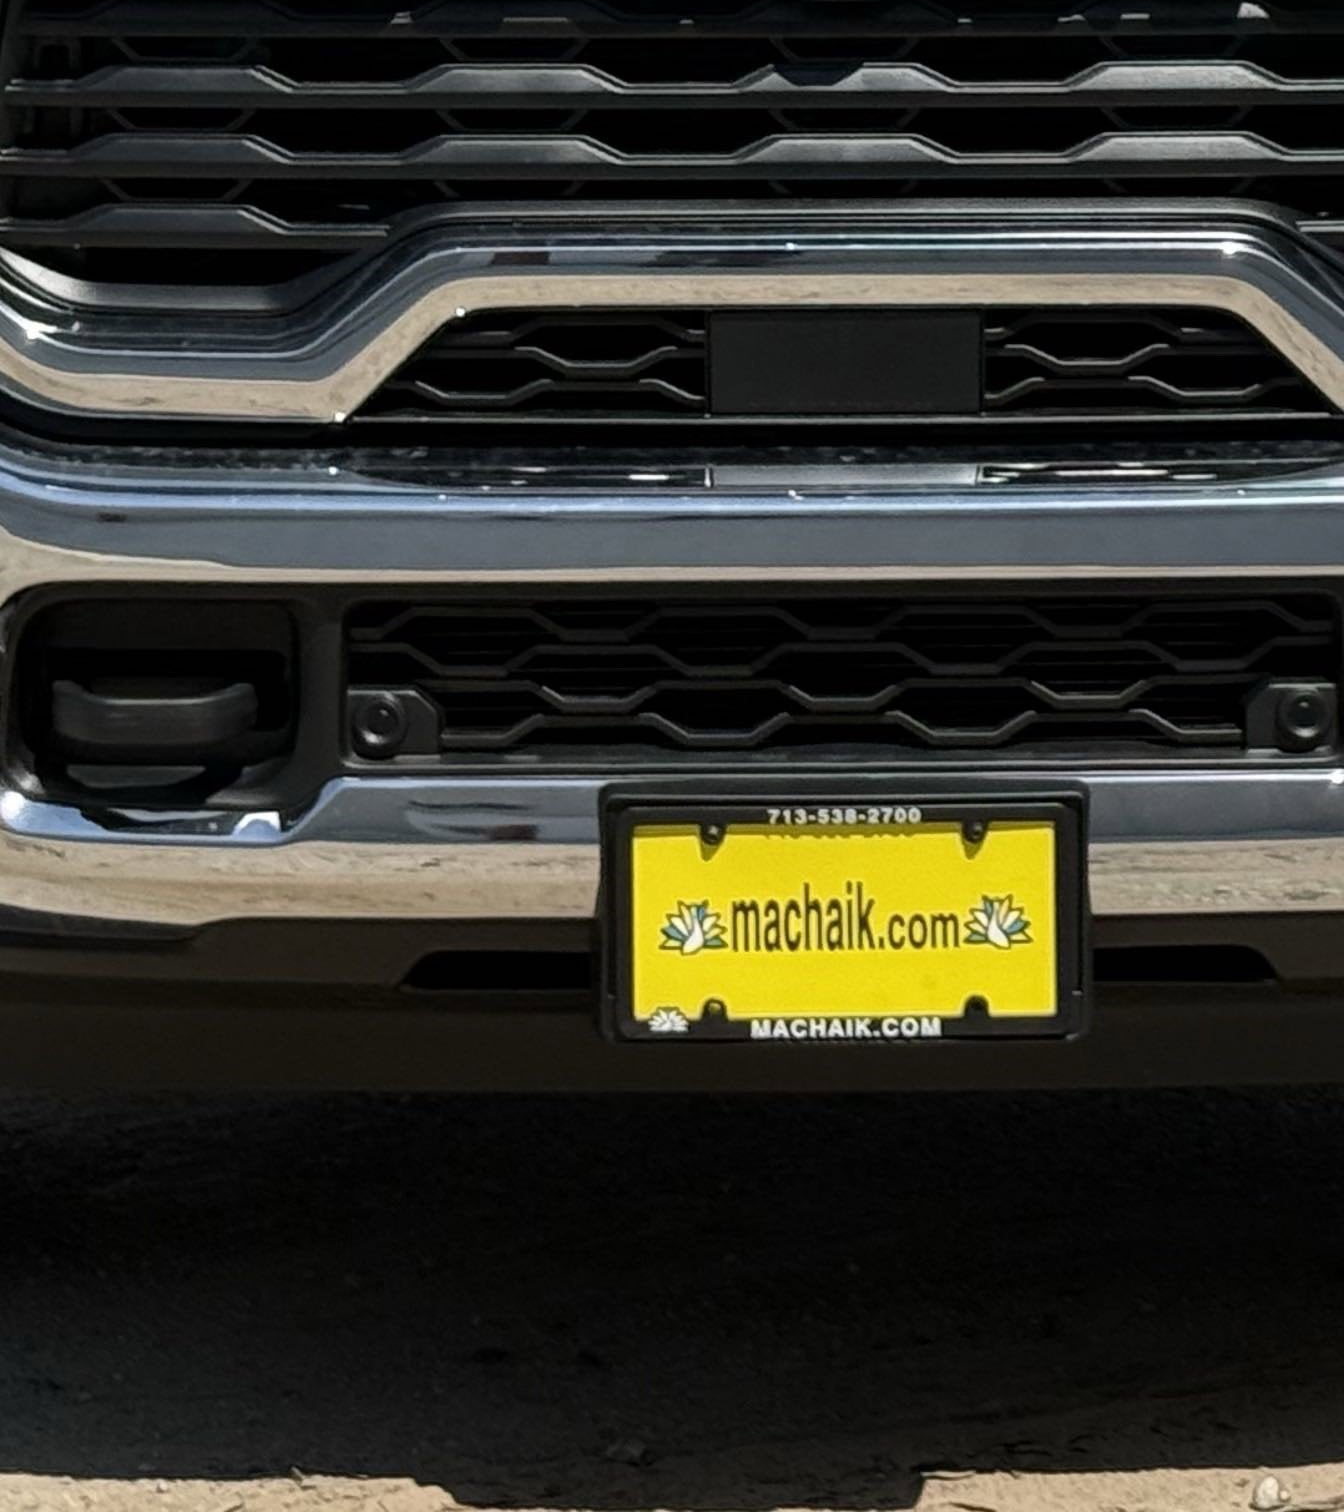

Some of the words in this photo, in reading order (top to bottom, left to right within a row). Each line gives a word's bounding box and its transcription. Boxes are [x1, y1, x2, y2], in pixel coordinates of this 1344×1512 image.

[767, 807, 923, 826] 713-538-2700
[731, 881, 960, 953] machaik.com
[750, 1018, 942, 1039] MACHAIK.COM
